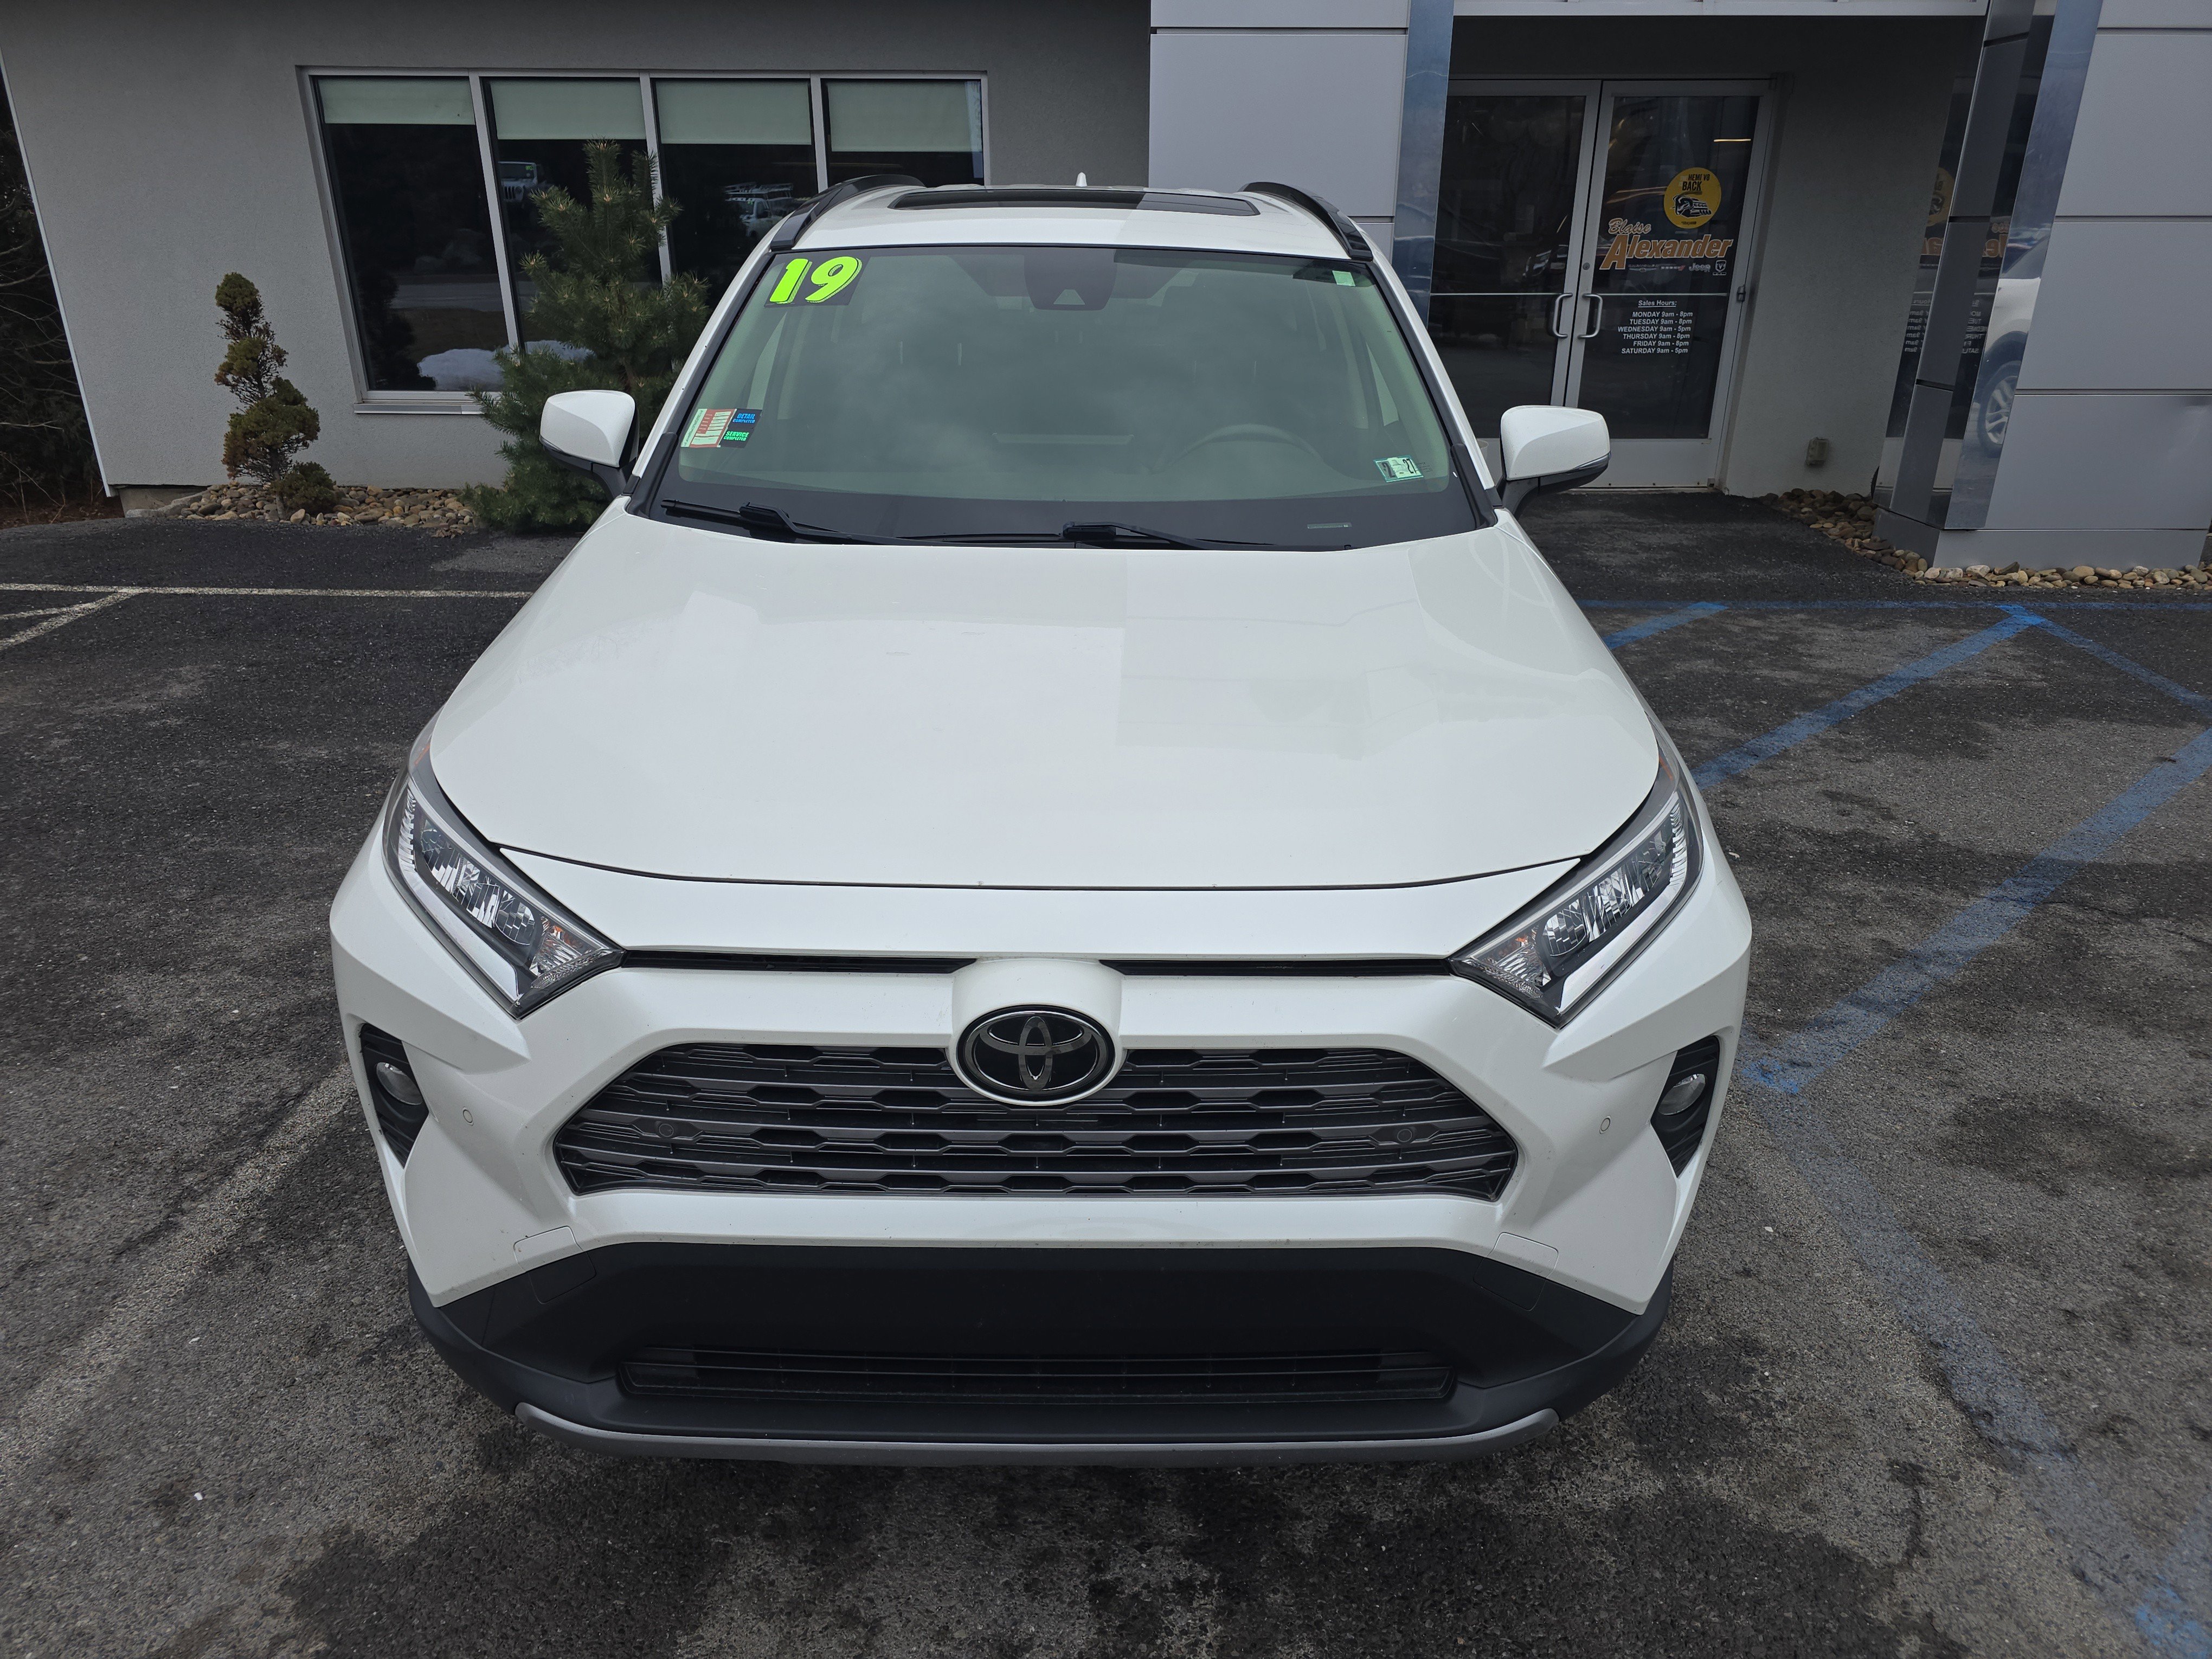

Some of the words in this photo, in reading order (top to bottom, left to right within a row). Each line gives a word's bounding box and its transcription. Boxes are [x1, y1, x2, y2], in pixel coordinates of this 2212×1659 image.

[1682, 181, 1702, 191] BACK
[1608, 218, 1651, 235] Blaise
[1599, 234, 1734, 270] Alexander
[1689, 262, 1711, 273] Jeep
[769, 256, 863, 304] 19
[1403, 459, 1417, 474] 27
